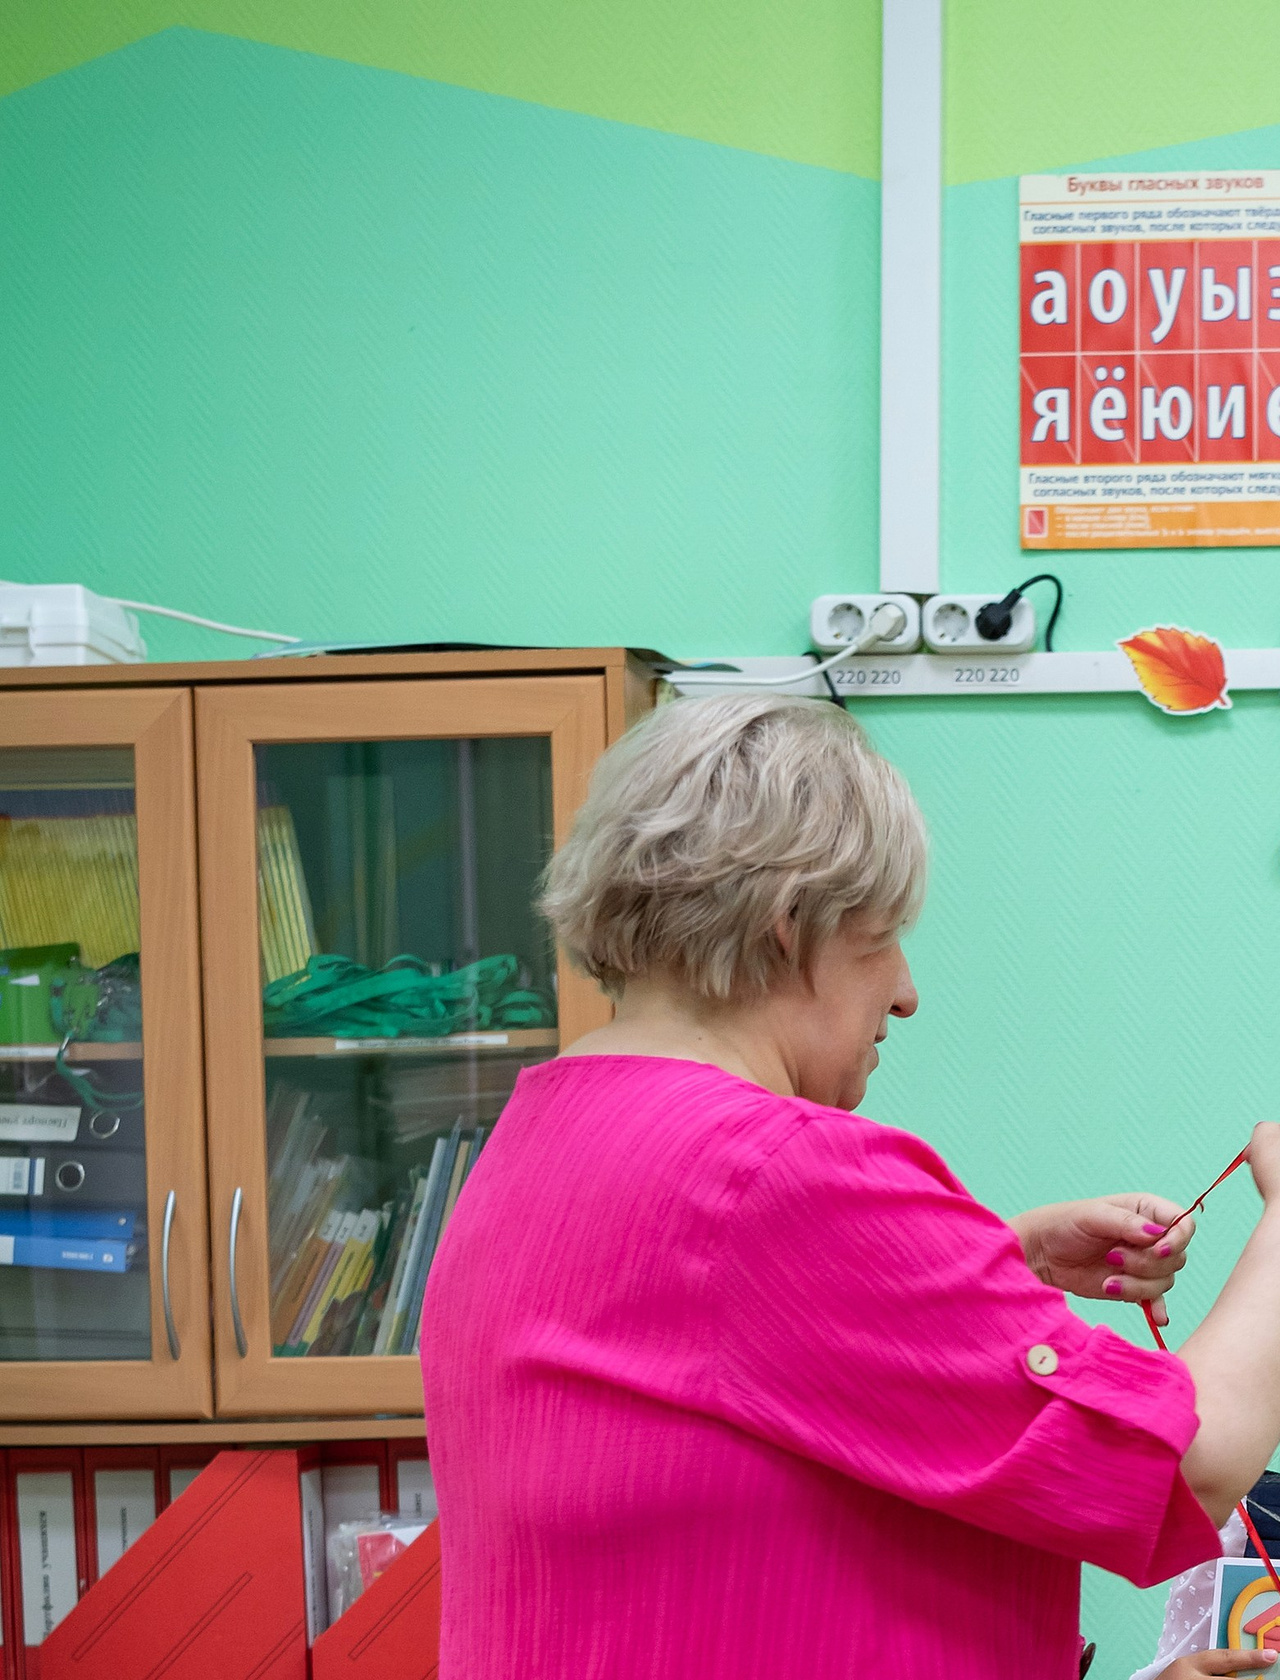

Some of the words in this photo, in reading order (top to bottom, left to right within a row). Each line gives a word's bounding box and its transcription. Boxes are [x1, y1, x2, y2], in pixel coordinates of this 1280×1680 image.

[1066, 177, 1122, 196] Буквы
[1127, 177, 1199, 192] гласных
[1205, 175, 1265, 193] звуков
[1024, 209, 1074, 222] Гласные
[1078, 209, 1129, 223] первого
[1132, 208, 1162, 222] ряда
[1166, 206, 1241, 220] обозначают
[1032, 222, 1096, 235] согласных
[1101, 222, 1144, 236] звуков,
[1149, 221, 1184, 232] после
[1189, 220, 1241, 234] которых
[1031, 269, 1069, 325] а
[1089, 268, 1129, 325] о
[1147, 267, 1187, 345] у
[1200, 266, 1252, 321] ы
[1031, 387, 1070, 442] я
[1090, 366, 1127, 441] ё
[1141, 384, 1193, 440] ю
[1206, 384, 1246, 439] и
[1028, 472, 1079, 485] Гласные
[1083, 473, 1133, 486] второго
[1137, 472, 1167, 485] ряда
[1170, 470, 1245, 484] обозначают
[1033, 486, 1097, 499] согласных
[1101, 485, 1146, 499] звуков,
[1150, 484, 1185, 496] после
[1190, 484, 1243, 498] которых
[835, 670, 867, 685] 220
[871, 670, 902, 685] 220
[954, 668, 985, 683] 220
[989, 668, 1020, 683] 220
